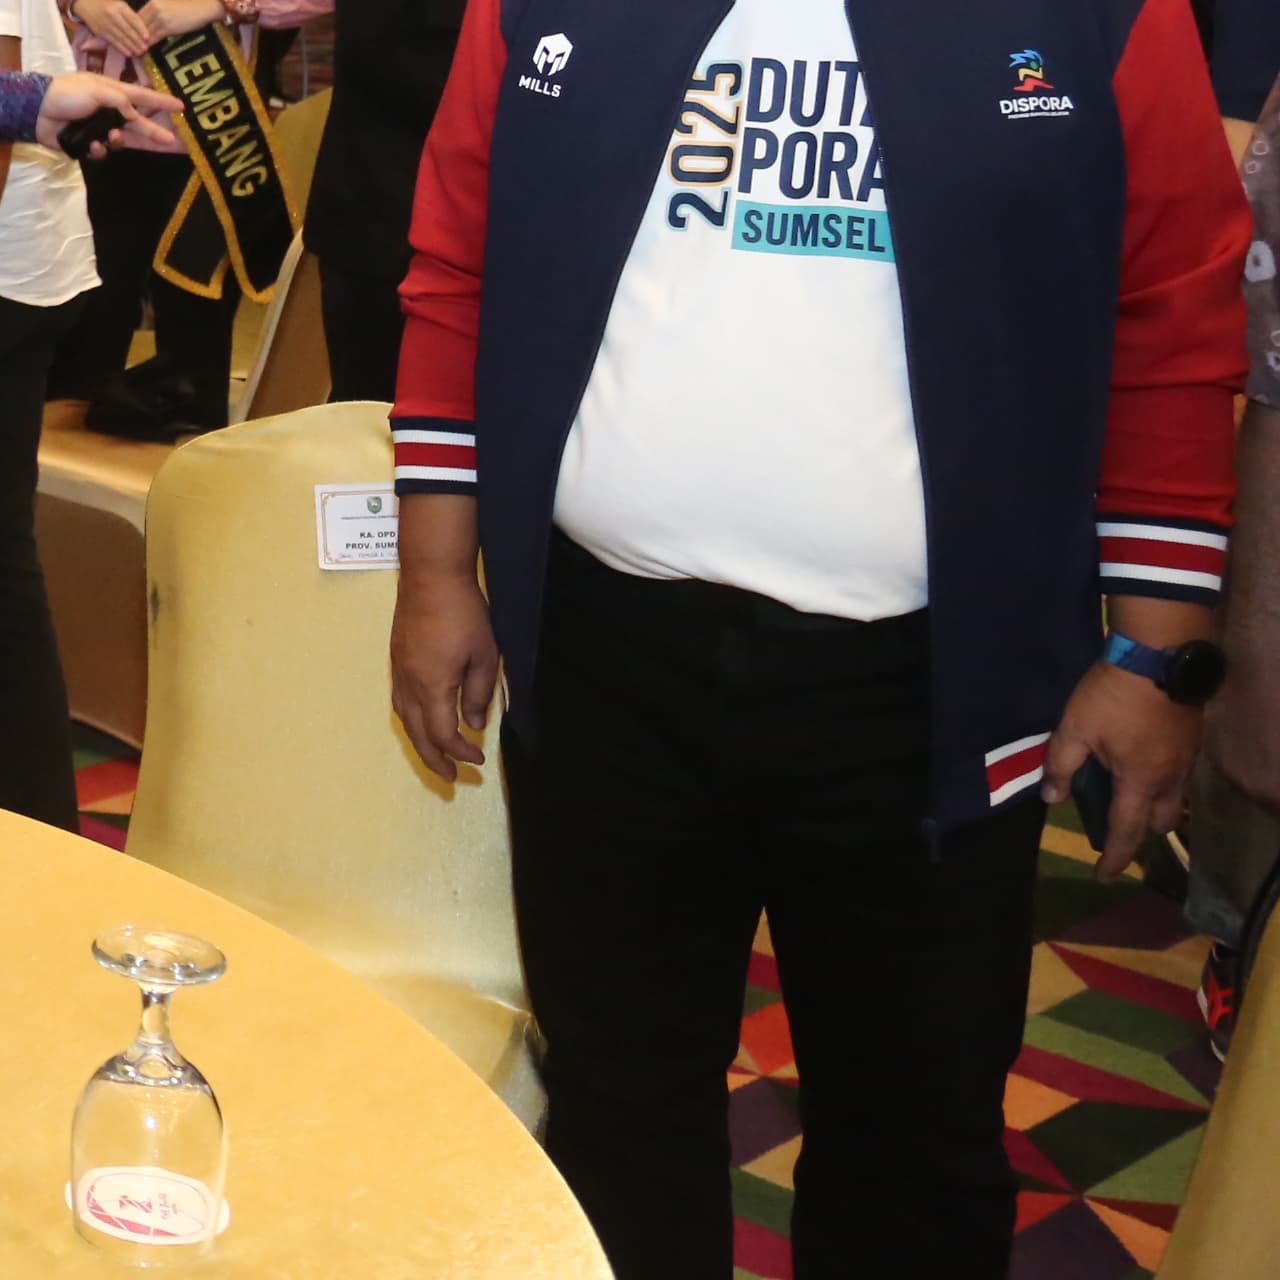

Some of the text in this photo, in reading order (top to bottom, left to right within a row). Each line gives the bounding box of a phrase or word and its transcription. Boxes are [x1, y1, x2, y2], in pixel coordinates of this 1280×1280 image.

[519, 74, 561, 97] MILLS
[1000, 96, 1074, 114] DISPORA
[160, 32, 268, 197] LEMBANG
[668, 62, 743, 230] 2025
[742, 209, 886, 253] SUMSEL
